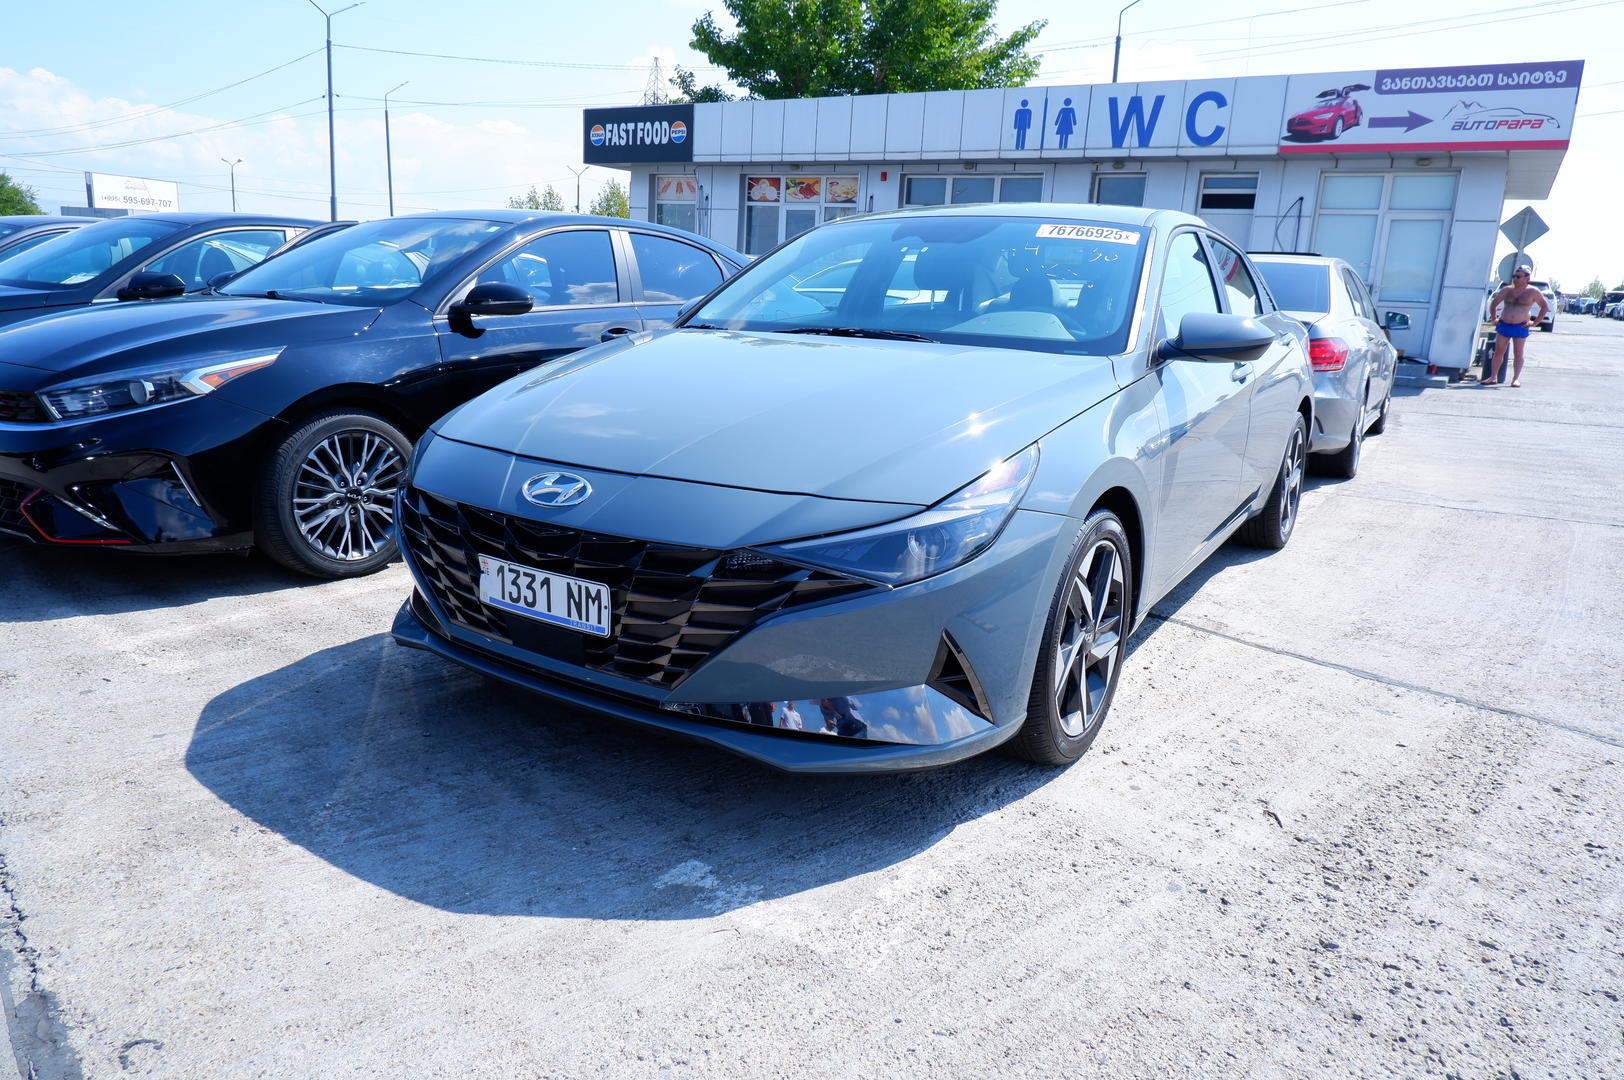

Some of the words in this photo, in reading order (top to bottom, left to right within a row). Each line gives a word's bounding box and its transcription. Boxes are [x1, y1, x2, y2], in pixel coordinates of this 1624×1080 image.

[1381, 73, 1494, 91] ვანთავსებთ
[1497, 70, 1568, 86] საიტზე
[605, 122, 635, 146] FAST
[637, 121, 670, 145] FOOD
[123, 195, 172, 208] 595-697-707
[496, 564, 552, 613] 1331
[566, 581, 602, 625] NM
[569, 619, 597, 632] TRANSIT
